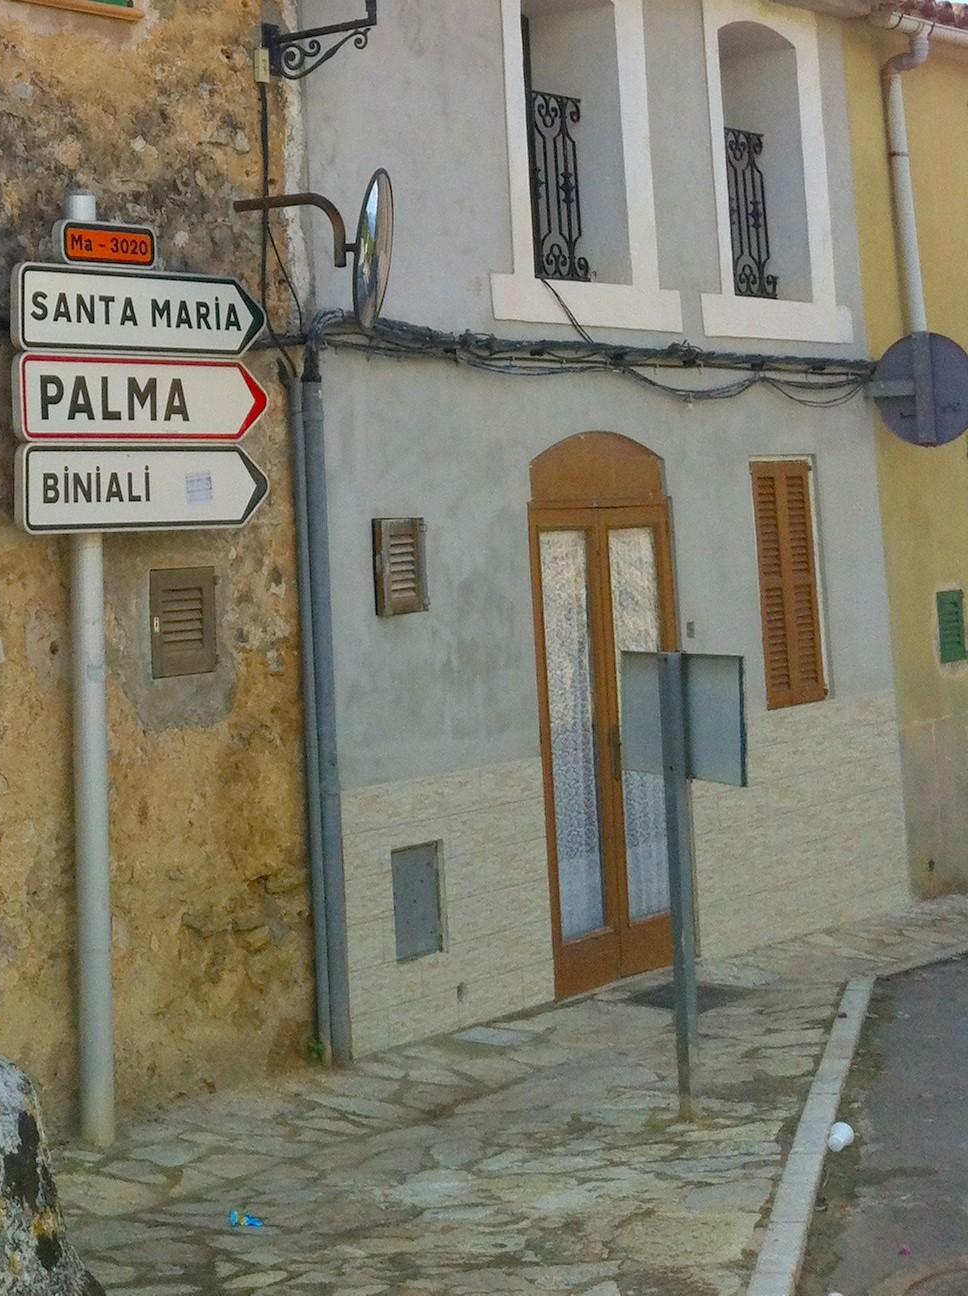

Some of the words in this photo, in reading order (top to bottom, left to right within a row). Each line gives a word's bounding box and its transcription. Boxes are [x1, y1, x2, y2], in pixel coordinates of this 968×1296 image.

[70, 233, 93, 252] Ma
[110, 237, 149, 256] 3020
[31, 291, 138, 327] SANTA
[40, 374, 190, 422] PALMA
